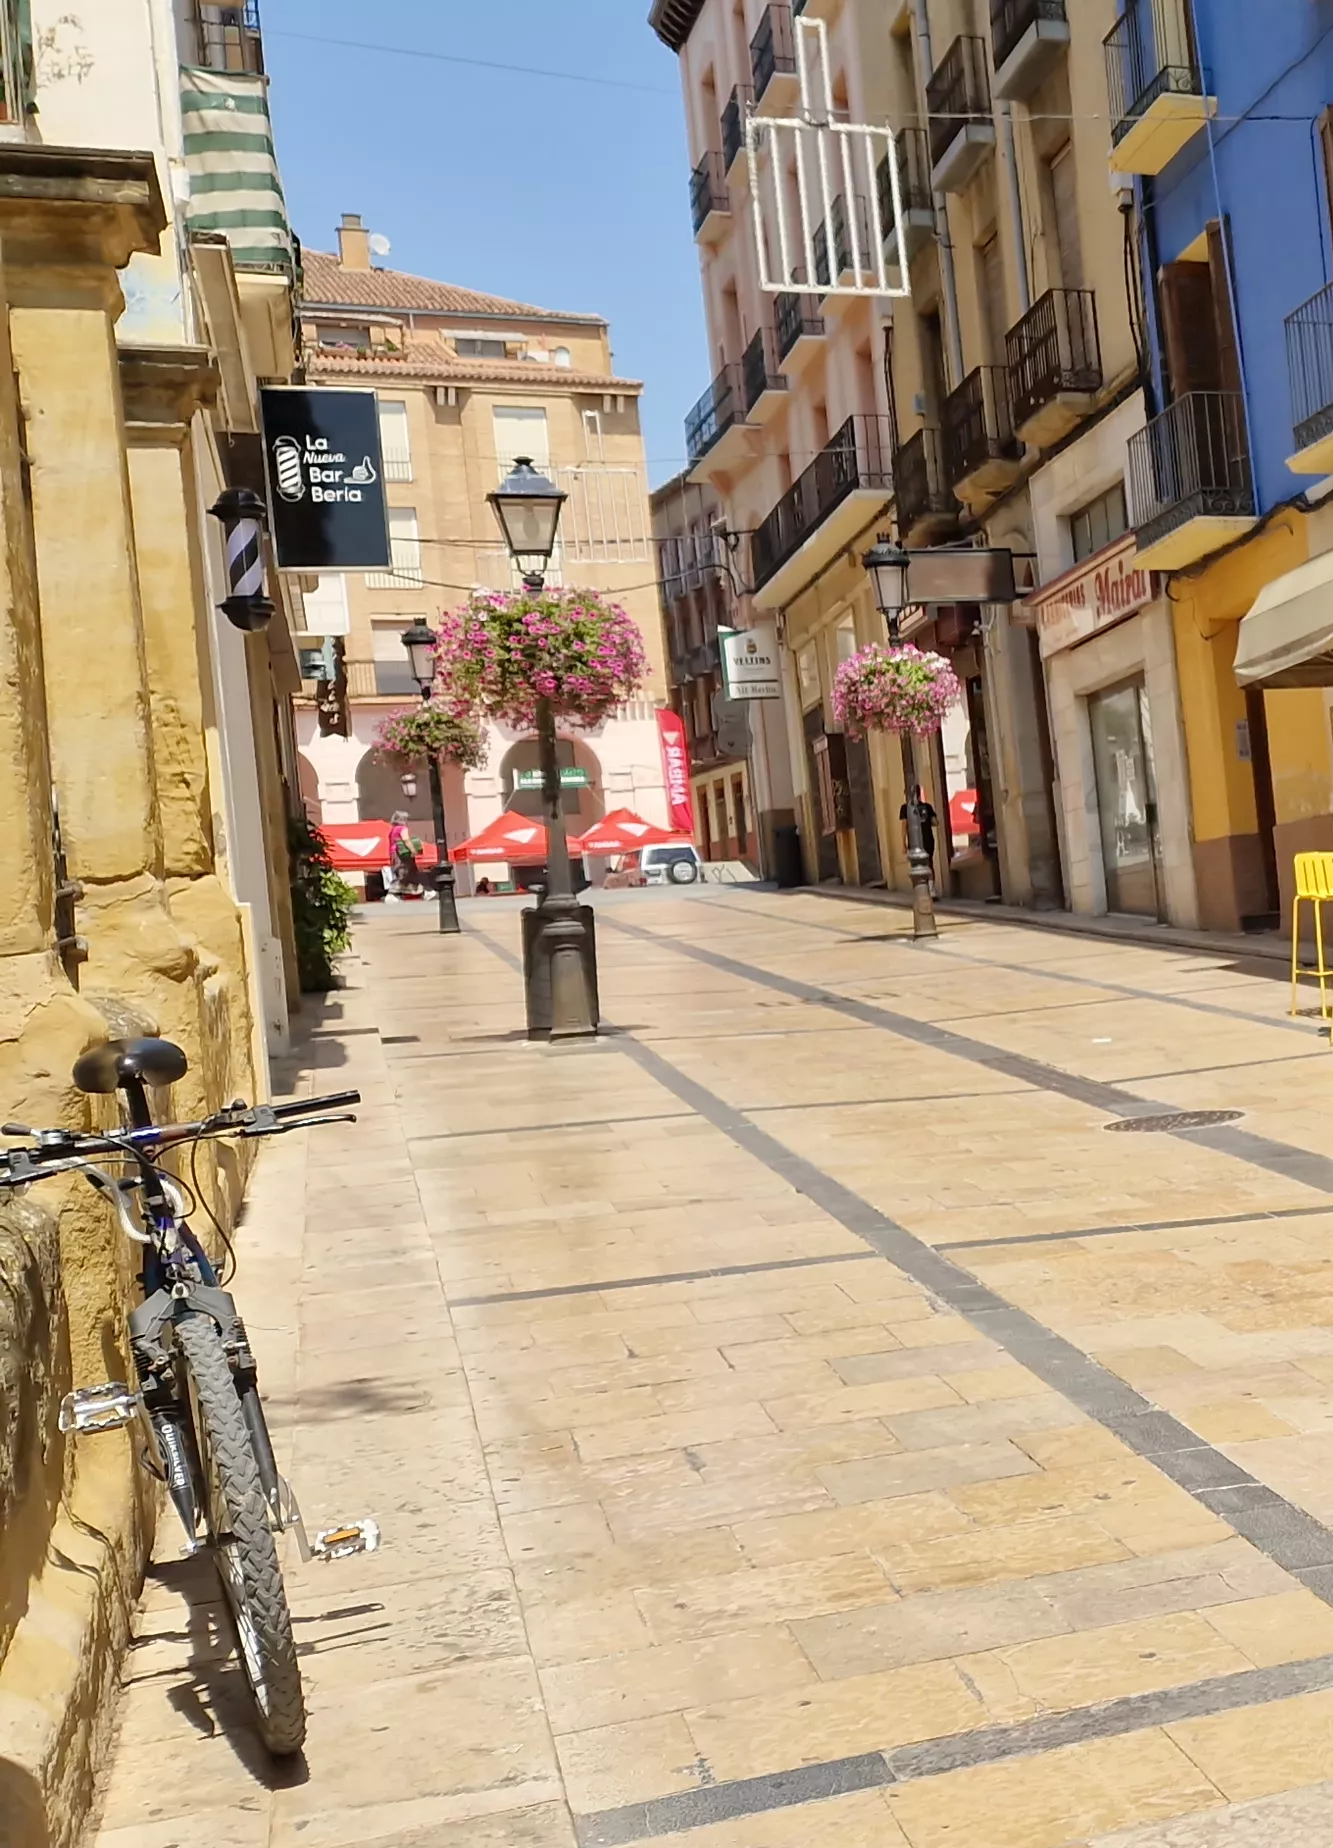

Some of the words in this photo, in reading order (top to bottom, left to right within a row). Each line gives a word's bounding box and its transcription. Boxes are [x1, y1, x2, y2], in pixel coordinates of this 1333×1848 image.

[305, 434, 329, 451] La
[303, 452, 346, 465] Nueva
[309, 467, 344, 483] Bar
